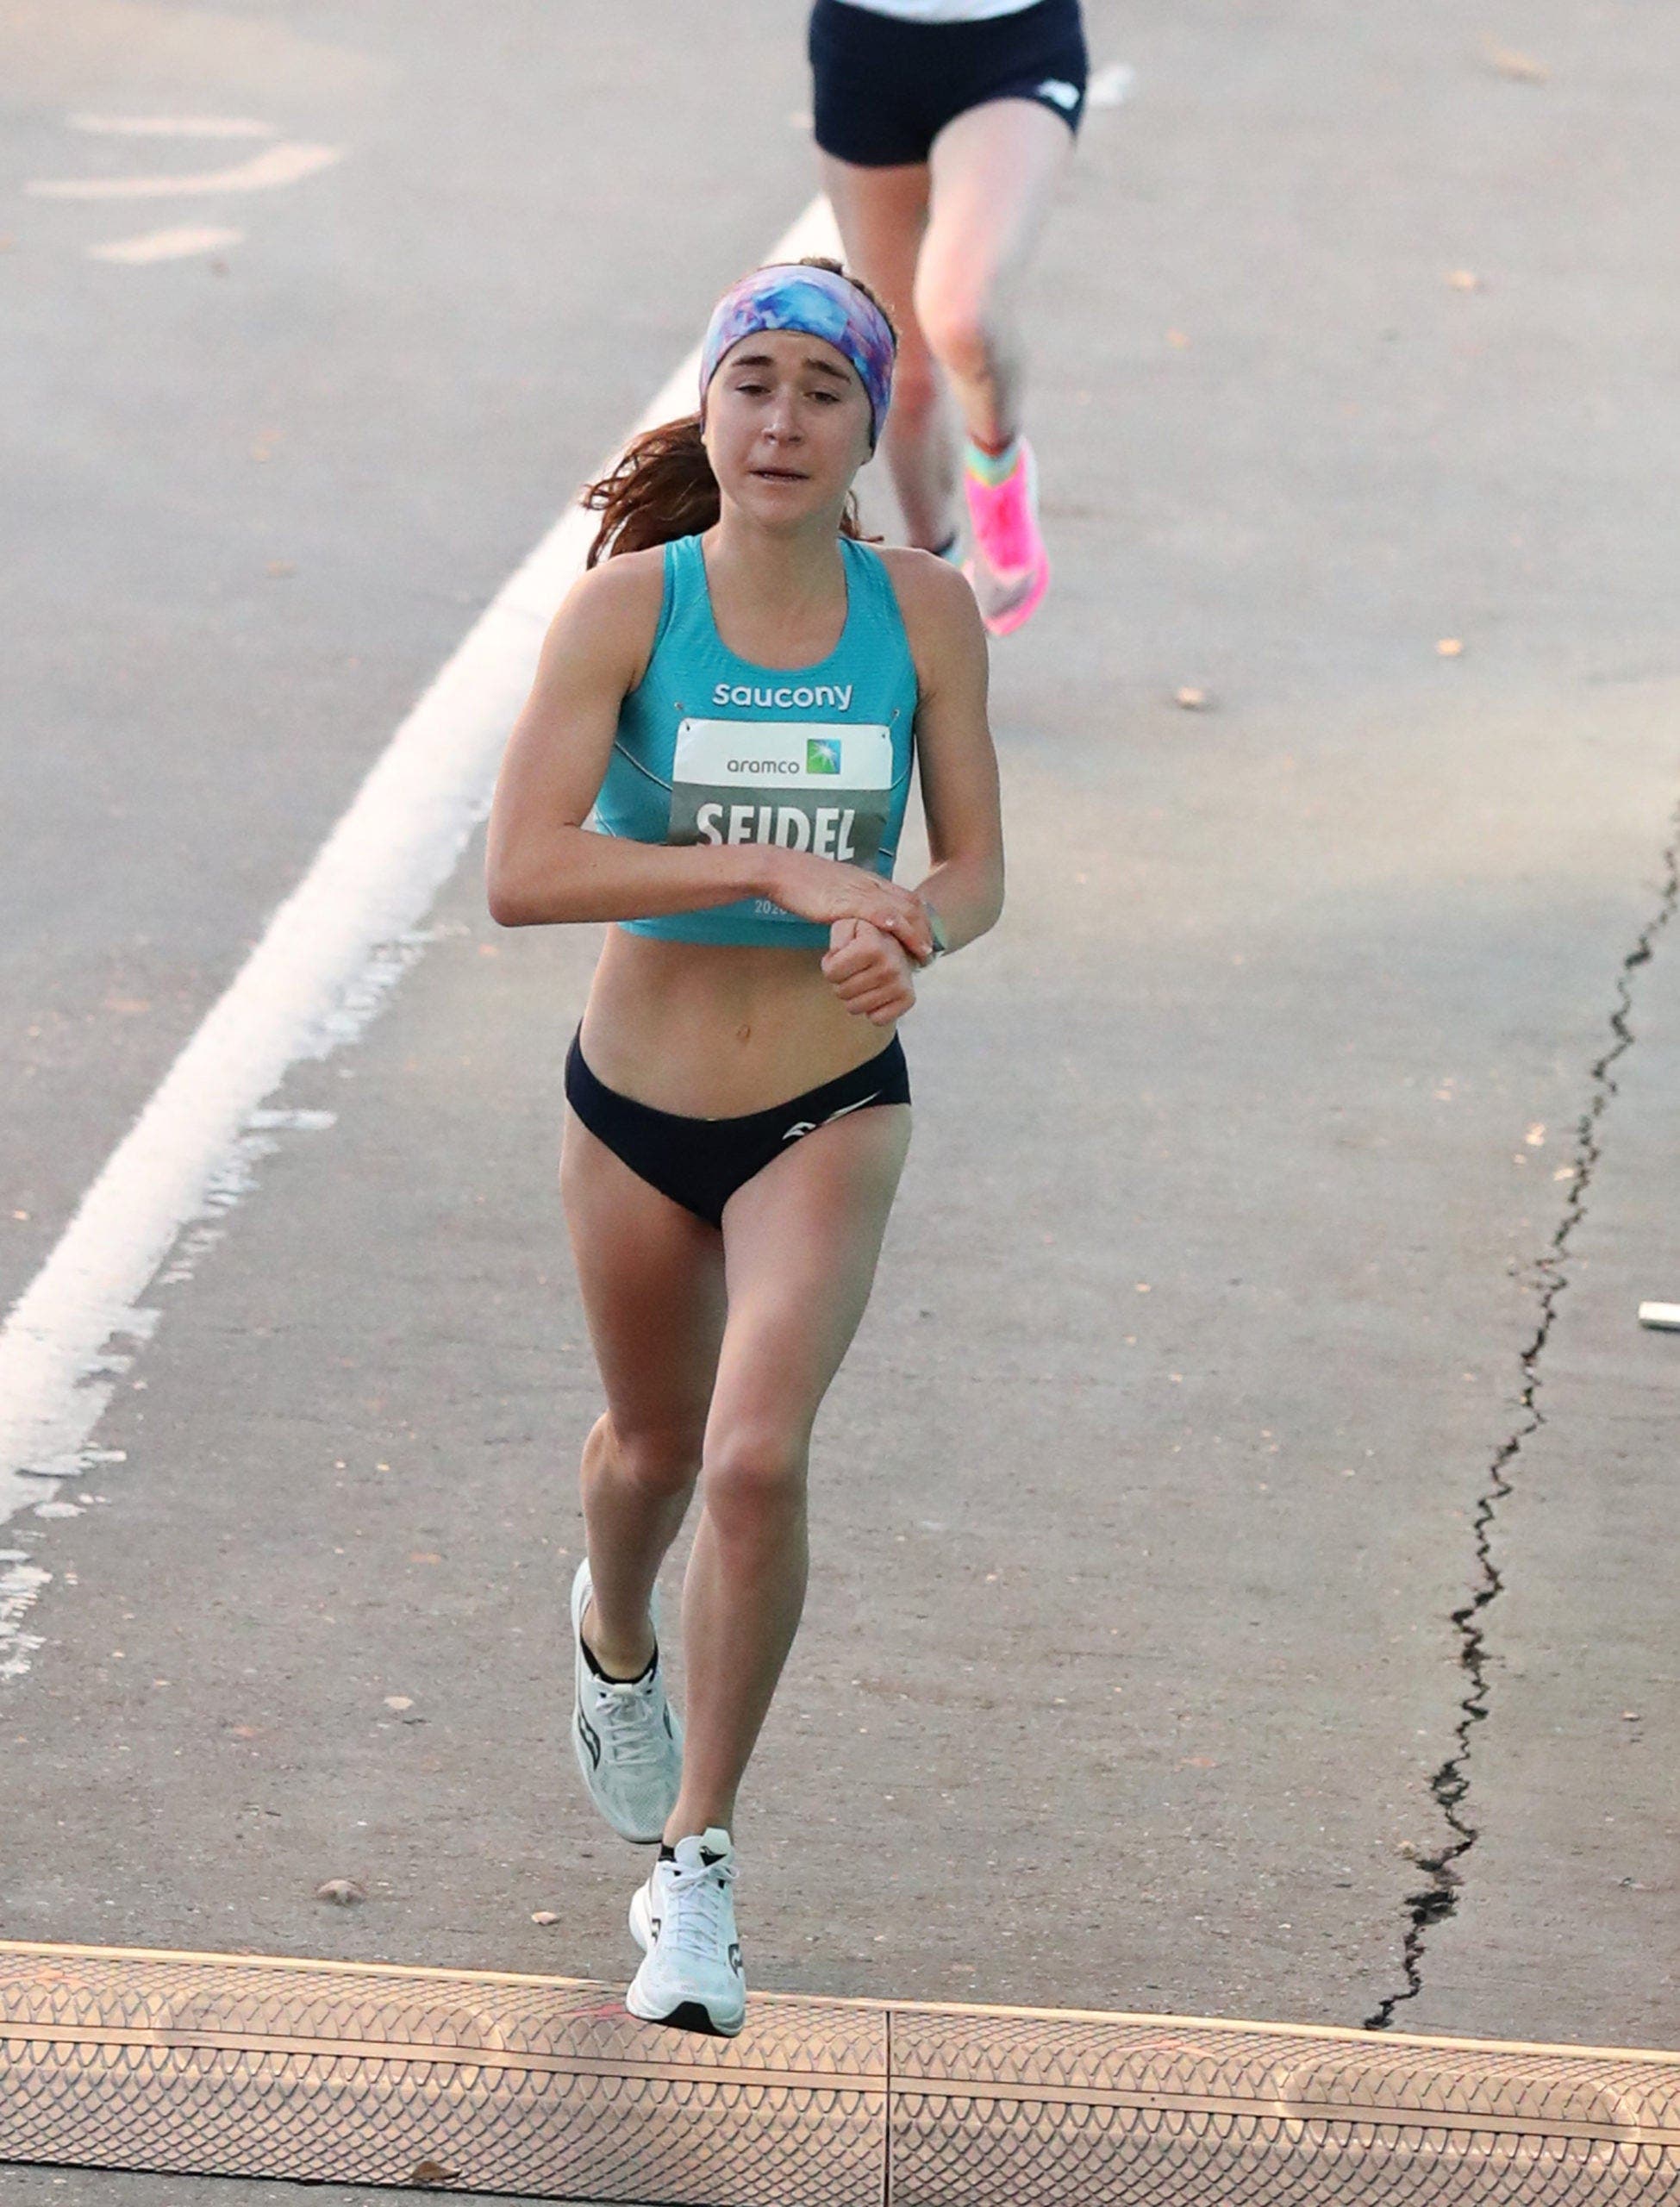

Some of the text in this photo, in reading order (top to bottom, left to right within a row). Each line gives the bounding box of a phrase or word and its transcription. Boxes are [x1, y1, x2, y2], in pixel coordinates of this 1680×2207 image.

[712, 683, 852, 711] saucony
[727, 758, 800, 774] aramco
[696, 803, 855, 861] SEIDEL
